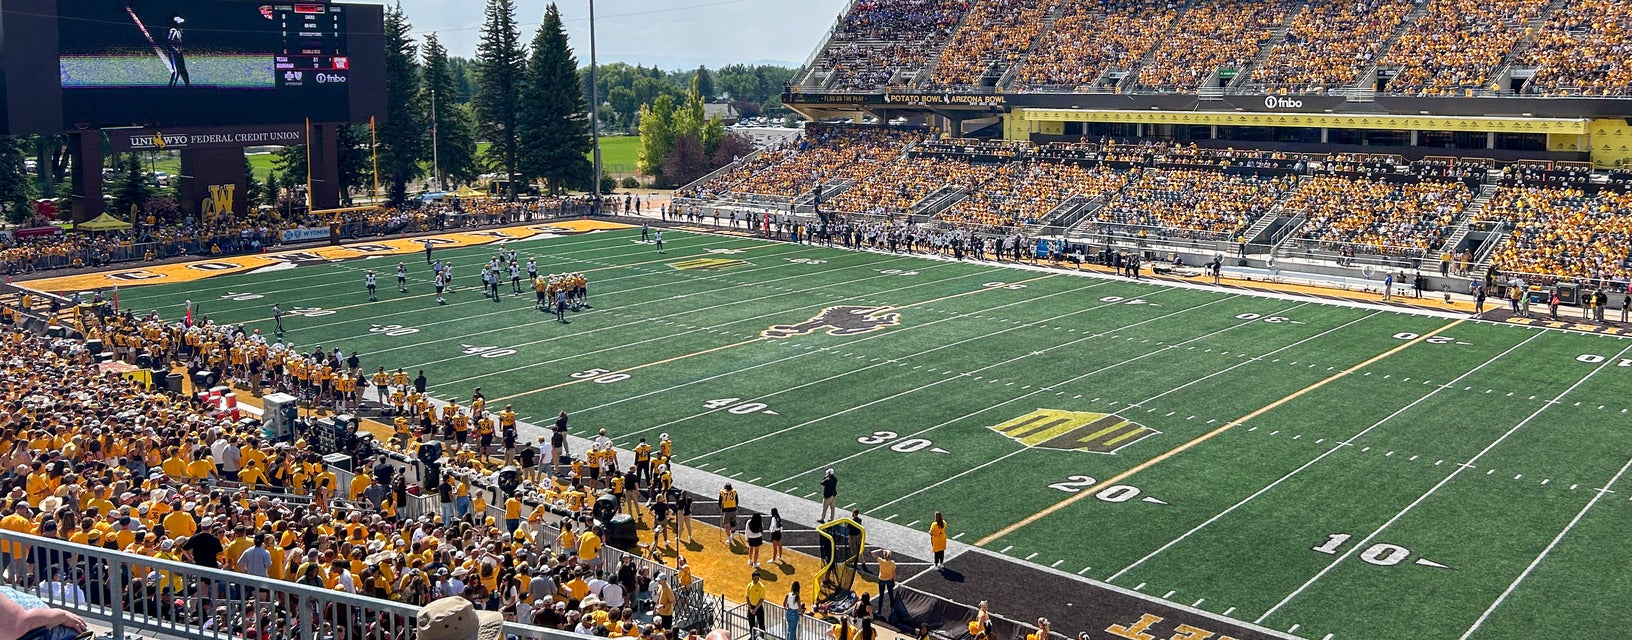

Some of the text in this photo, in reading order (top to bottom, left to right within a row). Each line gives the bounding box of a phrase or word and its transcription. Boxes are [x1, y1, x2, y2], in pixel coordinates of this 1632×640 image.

[327, 74, 346, 83] fnbo
[1278, 97, 1302, 109] fnbo
[163, 135, 187, 145] WYO
[191, 134, 234, 143] FEDERAL
[235, 133, 269, 142] CREDIT
[270, 131, 300, 140] UNION
[208, 184, 235, 217] W
[462, 345, 517, 358] 40
[569, 368, 632, 384] 50
[702, 397, 768, 415] 40
[856, 430, 933, 453] 30
[1047, 474, 1142, 503] 20
[724, 492, 735, 502] 73
[1311, 533, 1411, 566] 10
